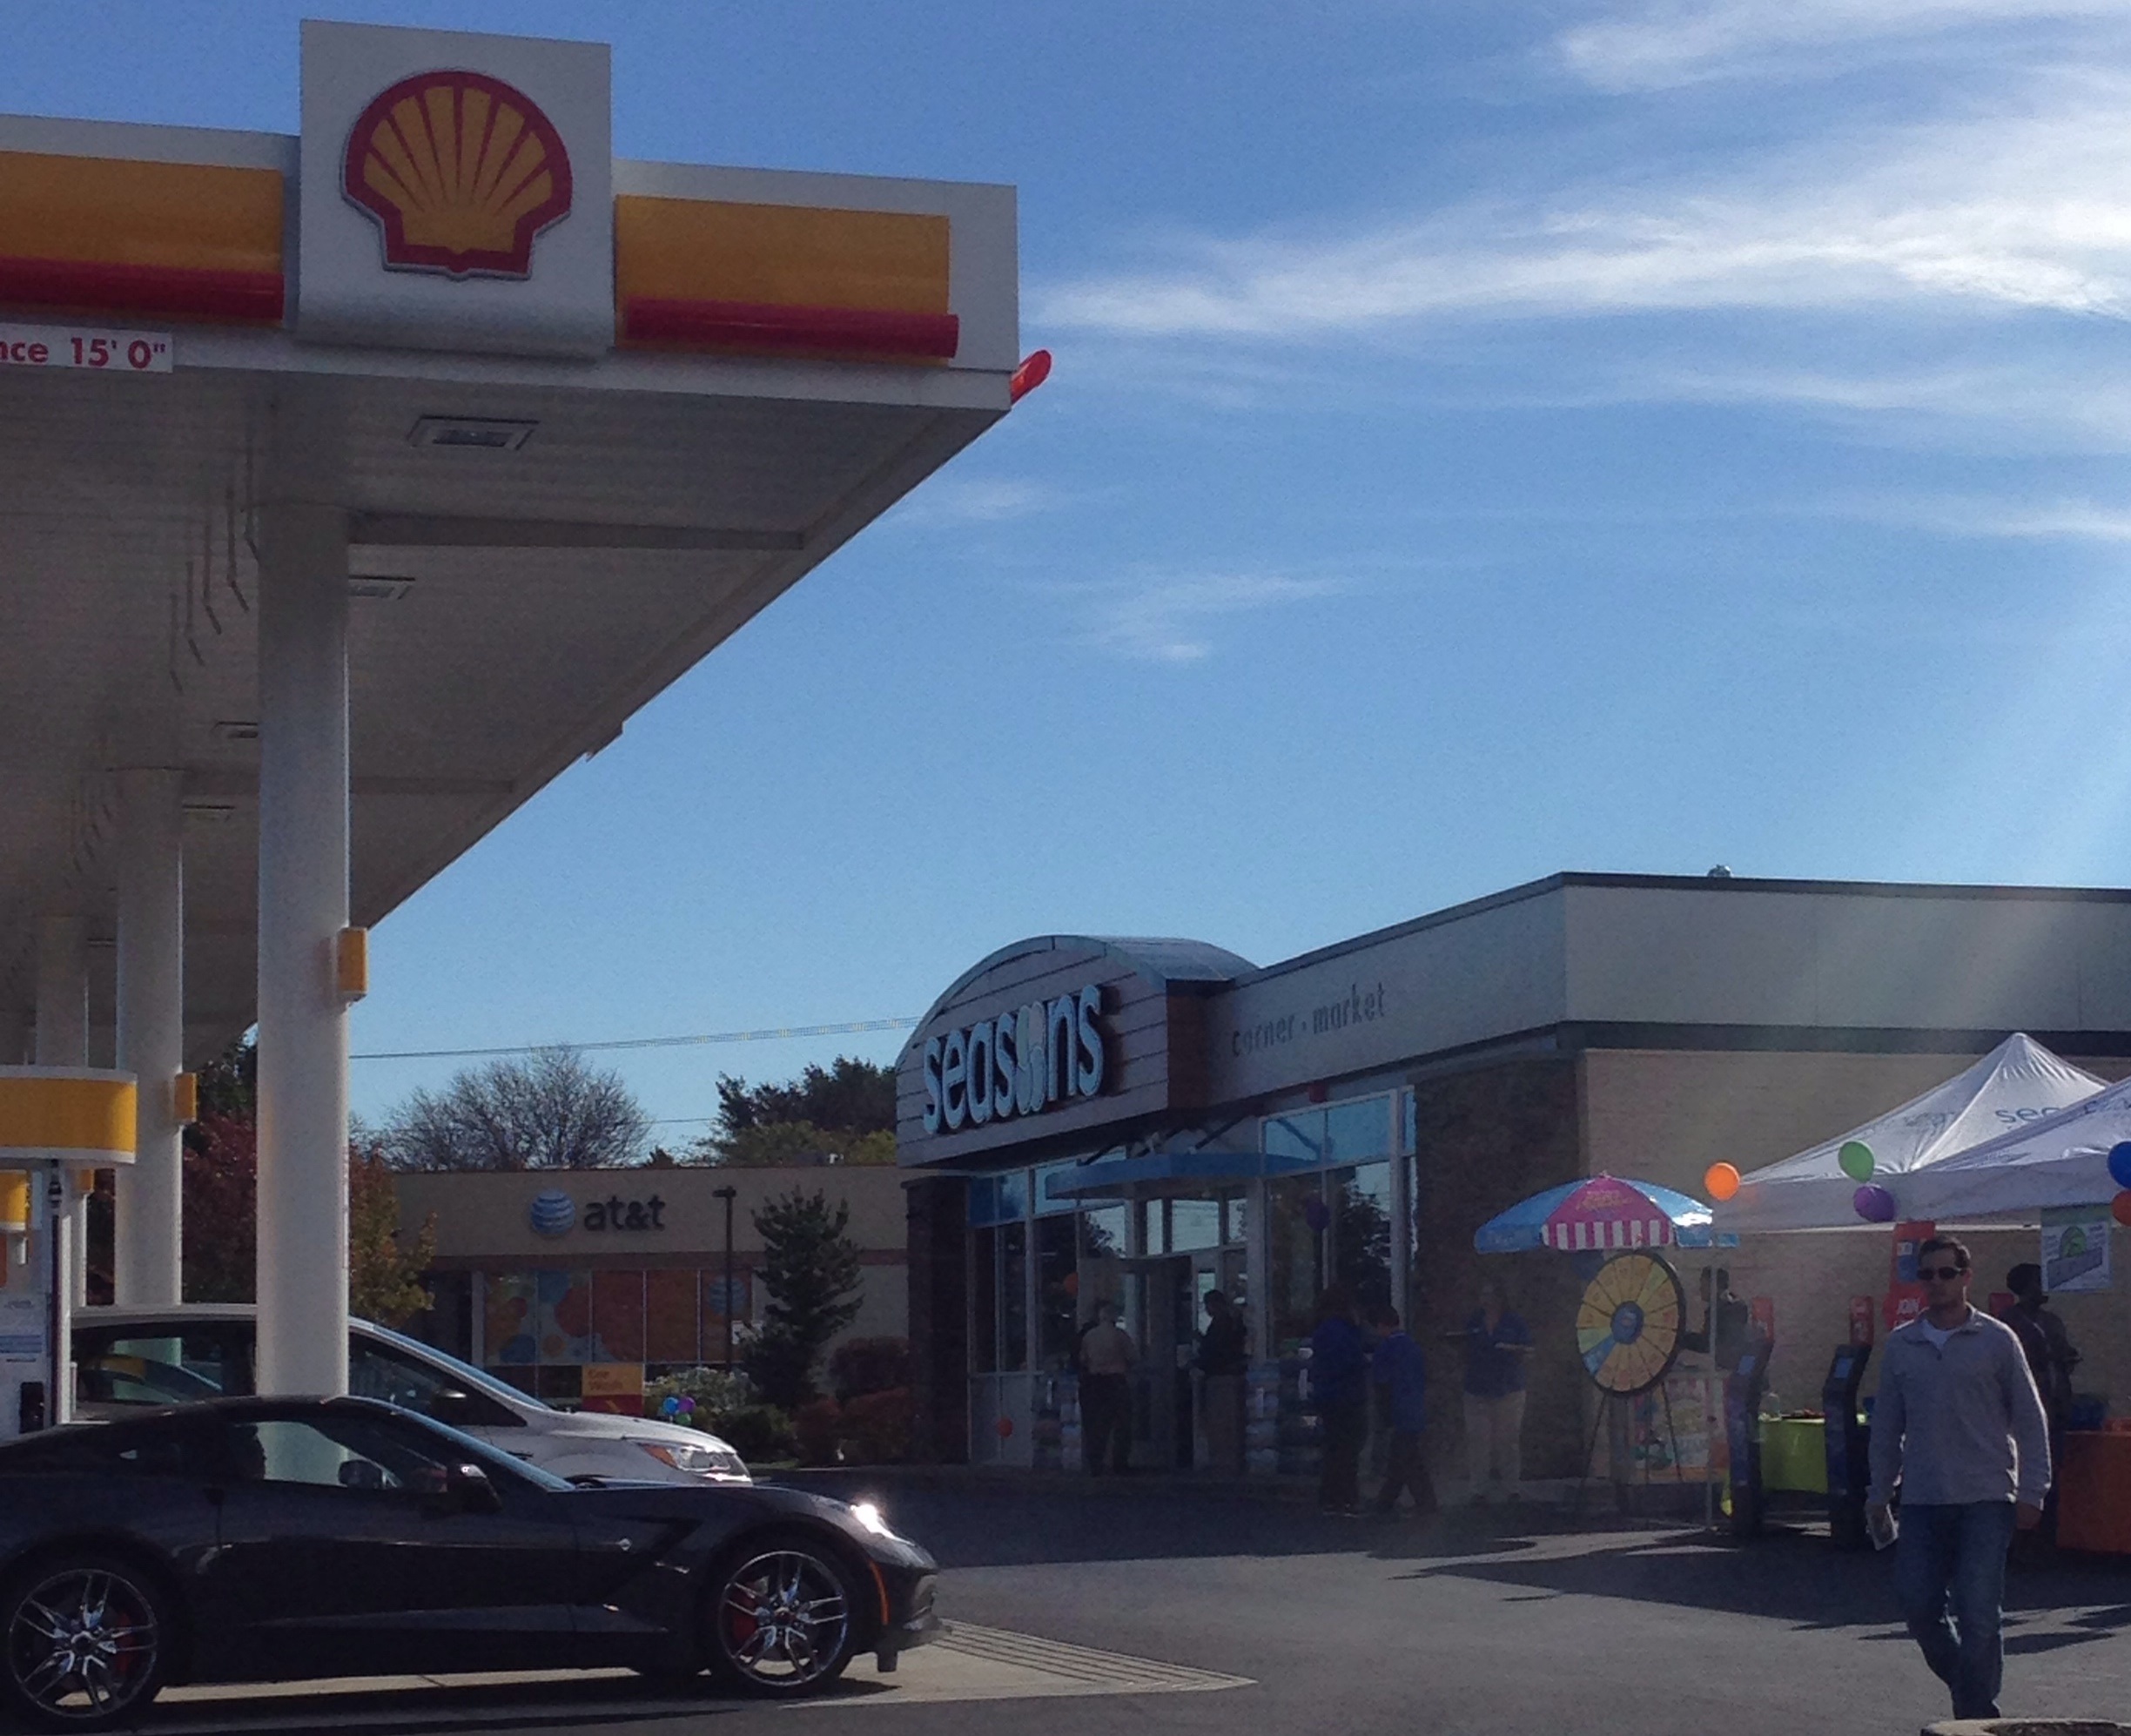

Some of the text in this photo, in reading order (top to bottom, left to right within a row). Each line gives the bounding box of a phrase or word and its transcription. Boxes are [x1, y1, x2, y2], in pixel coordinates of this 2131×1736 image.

[71, 337, 117, 367] 15'
[128, 340, 166, 369] 0"
[1232, 982, 1385, 1057] corner market
[583, 1194, 666, 1232] at&t
